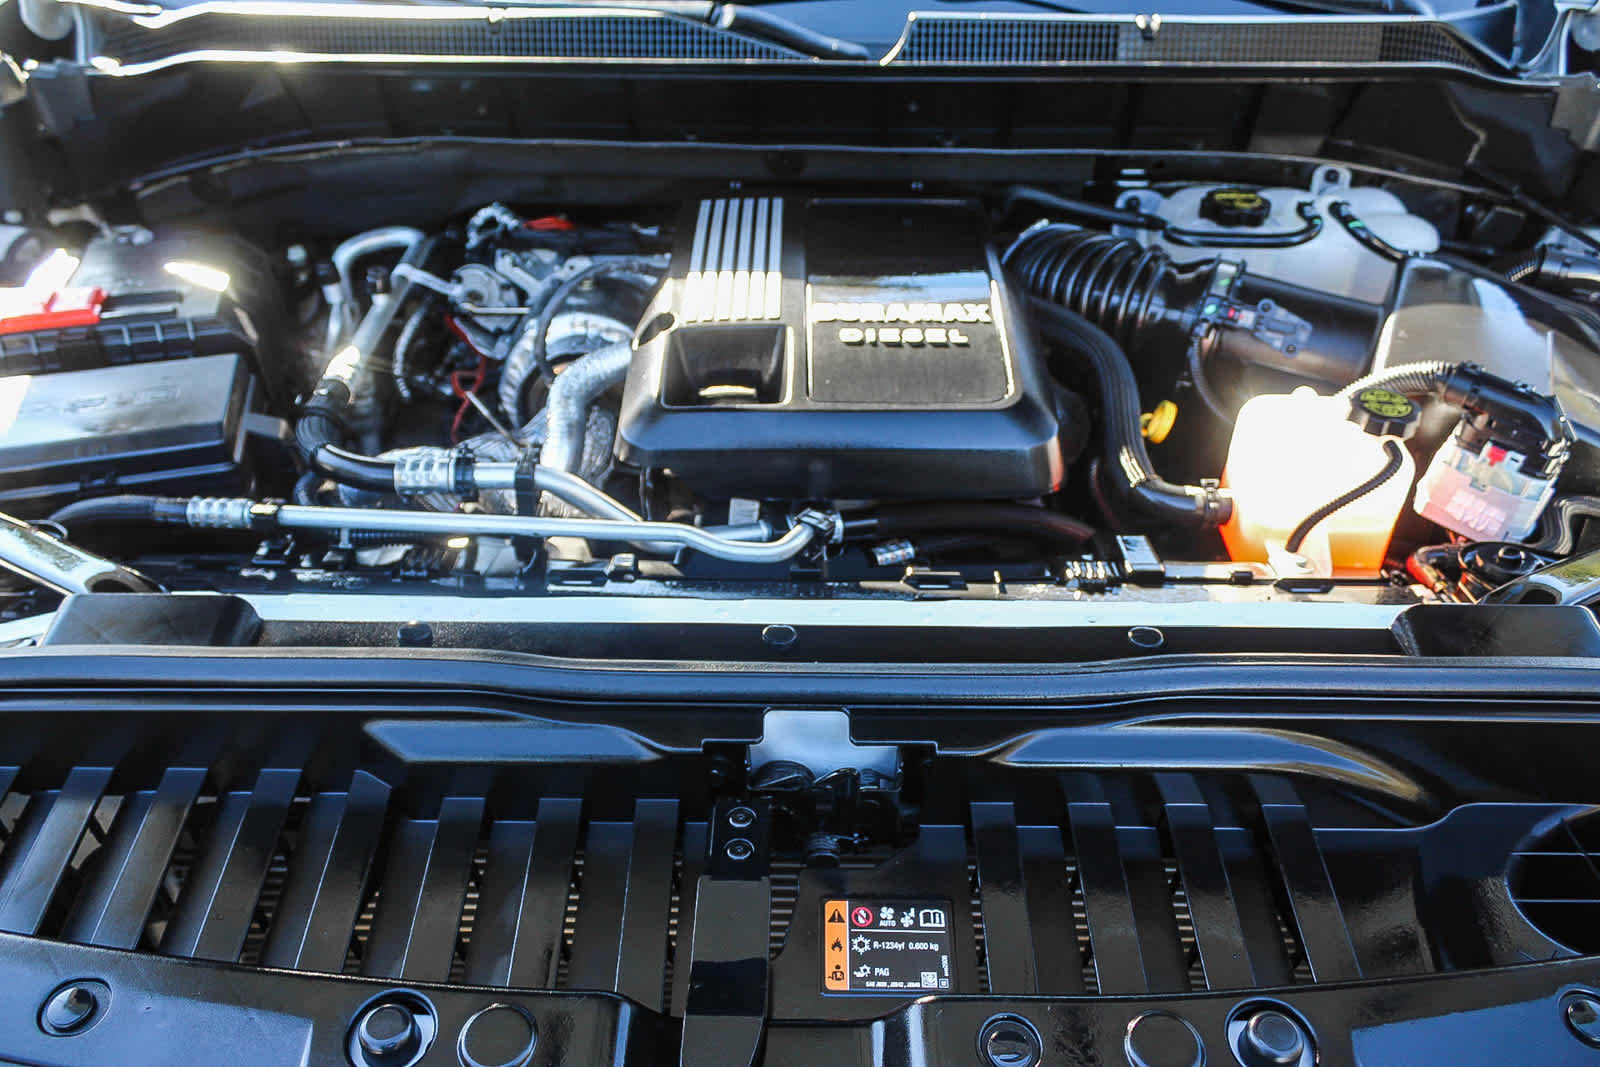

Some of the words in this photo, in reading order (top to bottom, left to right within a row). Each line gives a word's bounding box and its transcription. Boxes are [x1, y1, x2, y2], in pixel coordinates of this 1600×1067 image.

[839, 328, 969, 343] DIESEL
[873, 941, 905, 951] R-1234yf
[929, 942, 939, 952] kg
[874, 967, 890, 977] PAG
